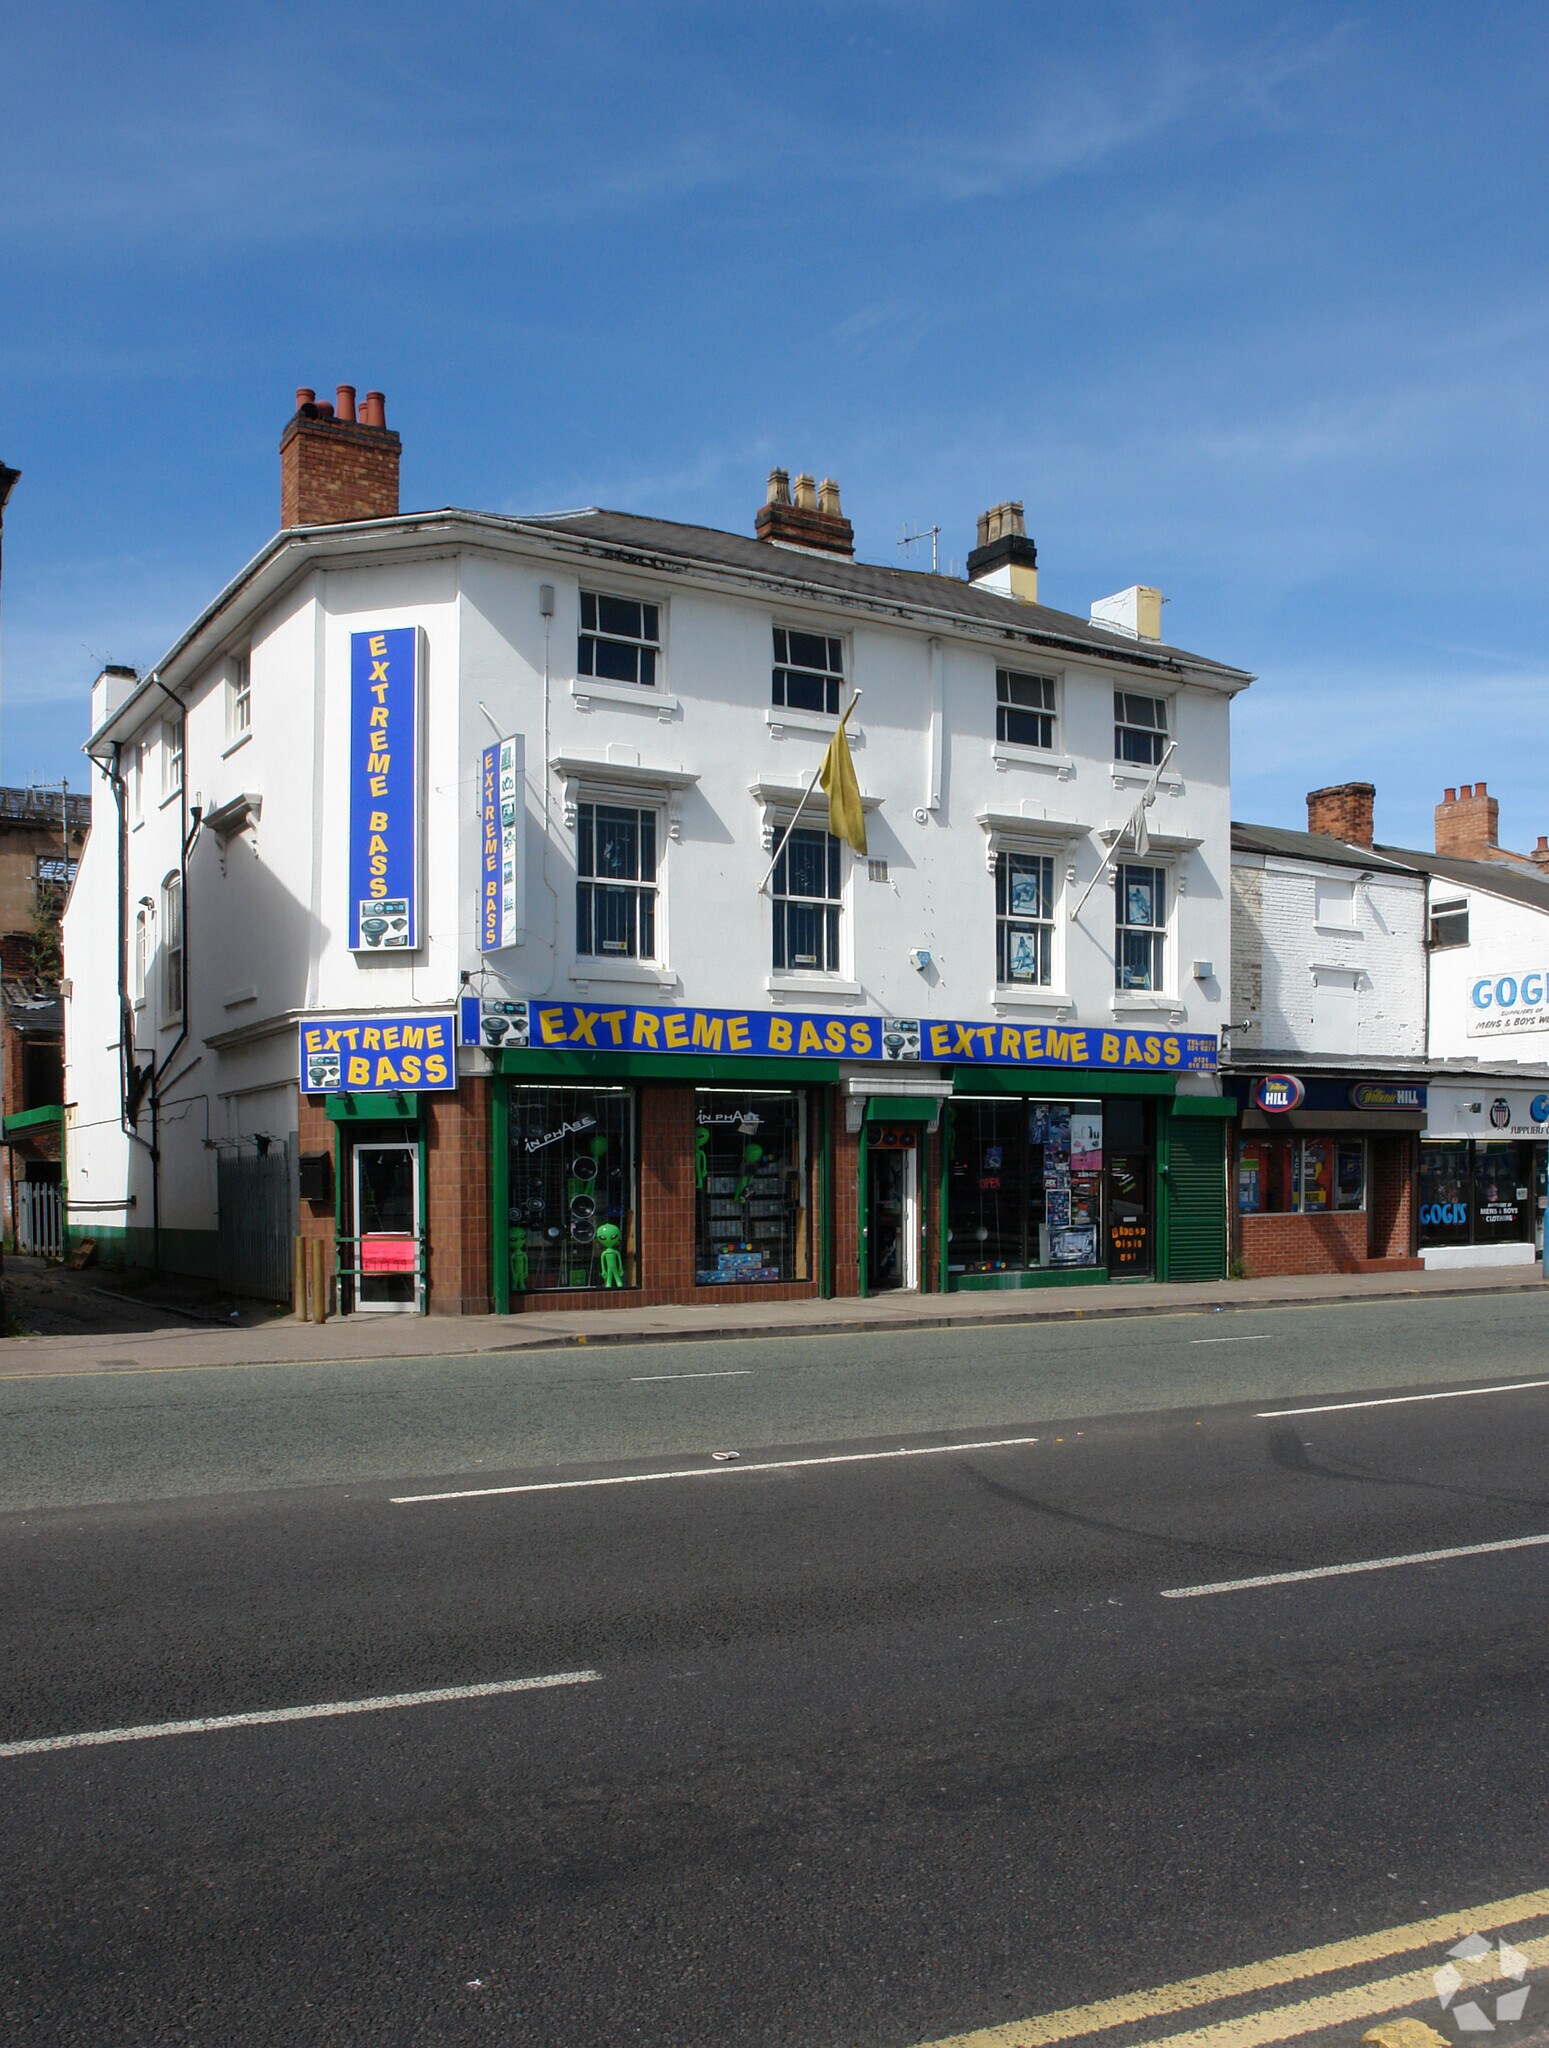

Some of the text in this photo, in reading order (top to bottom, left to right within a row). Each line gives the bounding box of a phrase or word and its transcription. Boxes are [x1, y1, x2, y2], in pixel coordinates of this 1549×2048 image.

[367, 635, 391, 898] EXTREME BASS
[484, 753, 498, 945] EXTREME BASS
[539, 1007, 873, 1054] EXTREME BASS
[1476, 1019, 1502, 1029] MENS
[1514, 1016, 1536, 1026] BOYS
[305, 1024, 445, 1053] EXTREME
[929, 1024, 1181, 1065] EXTREME BASS
[348, 1054, 448, 1086] BASS
[1265, 1092, 1288, 1105] HILL
[1397, 1090, 1419, 1104] HILL
[1510, 1126, 1544, 1134] SUPPLIERS
